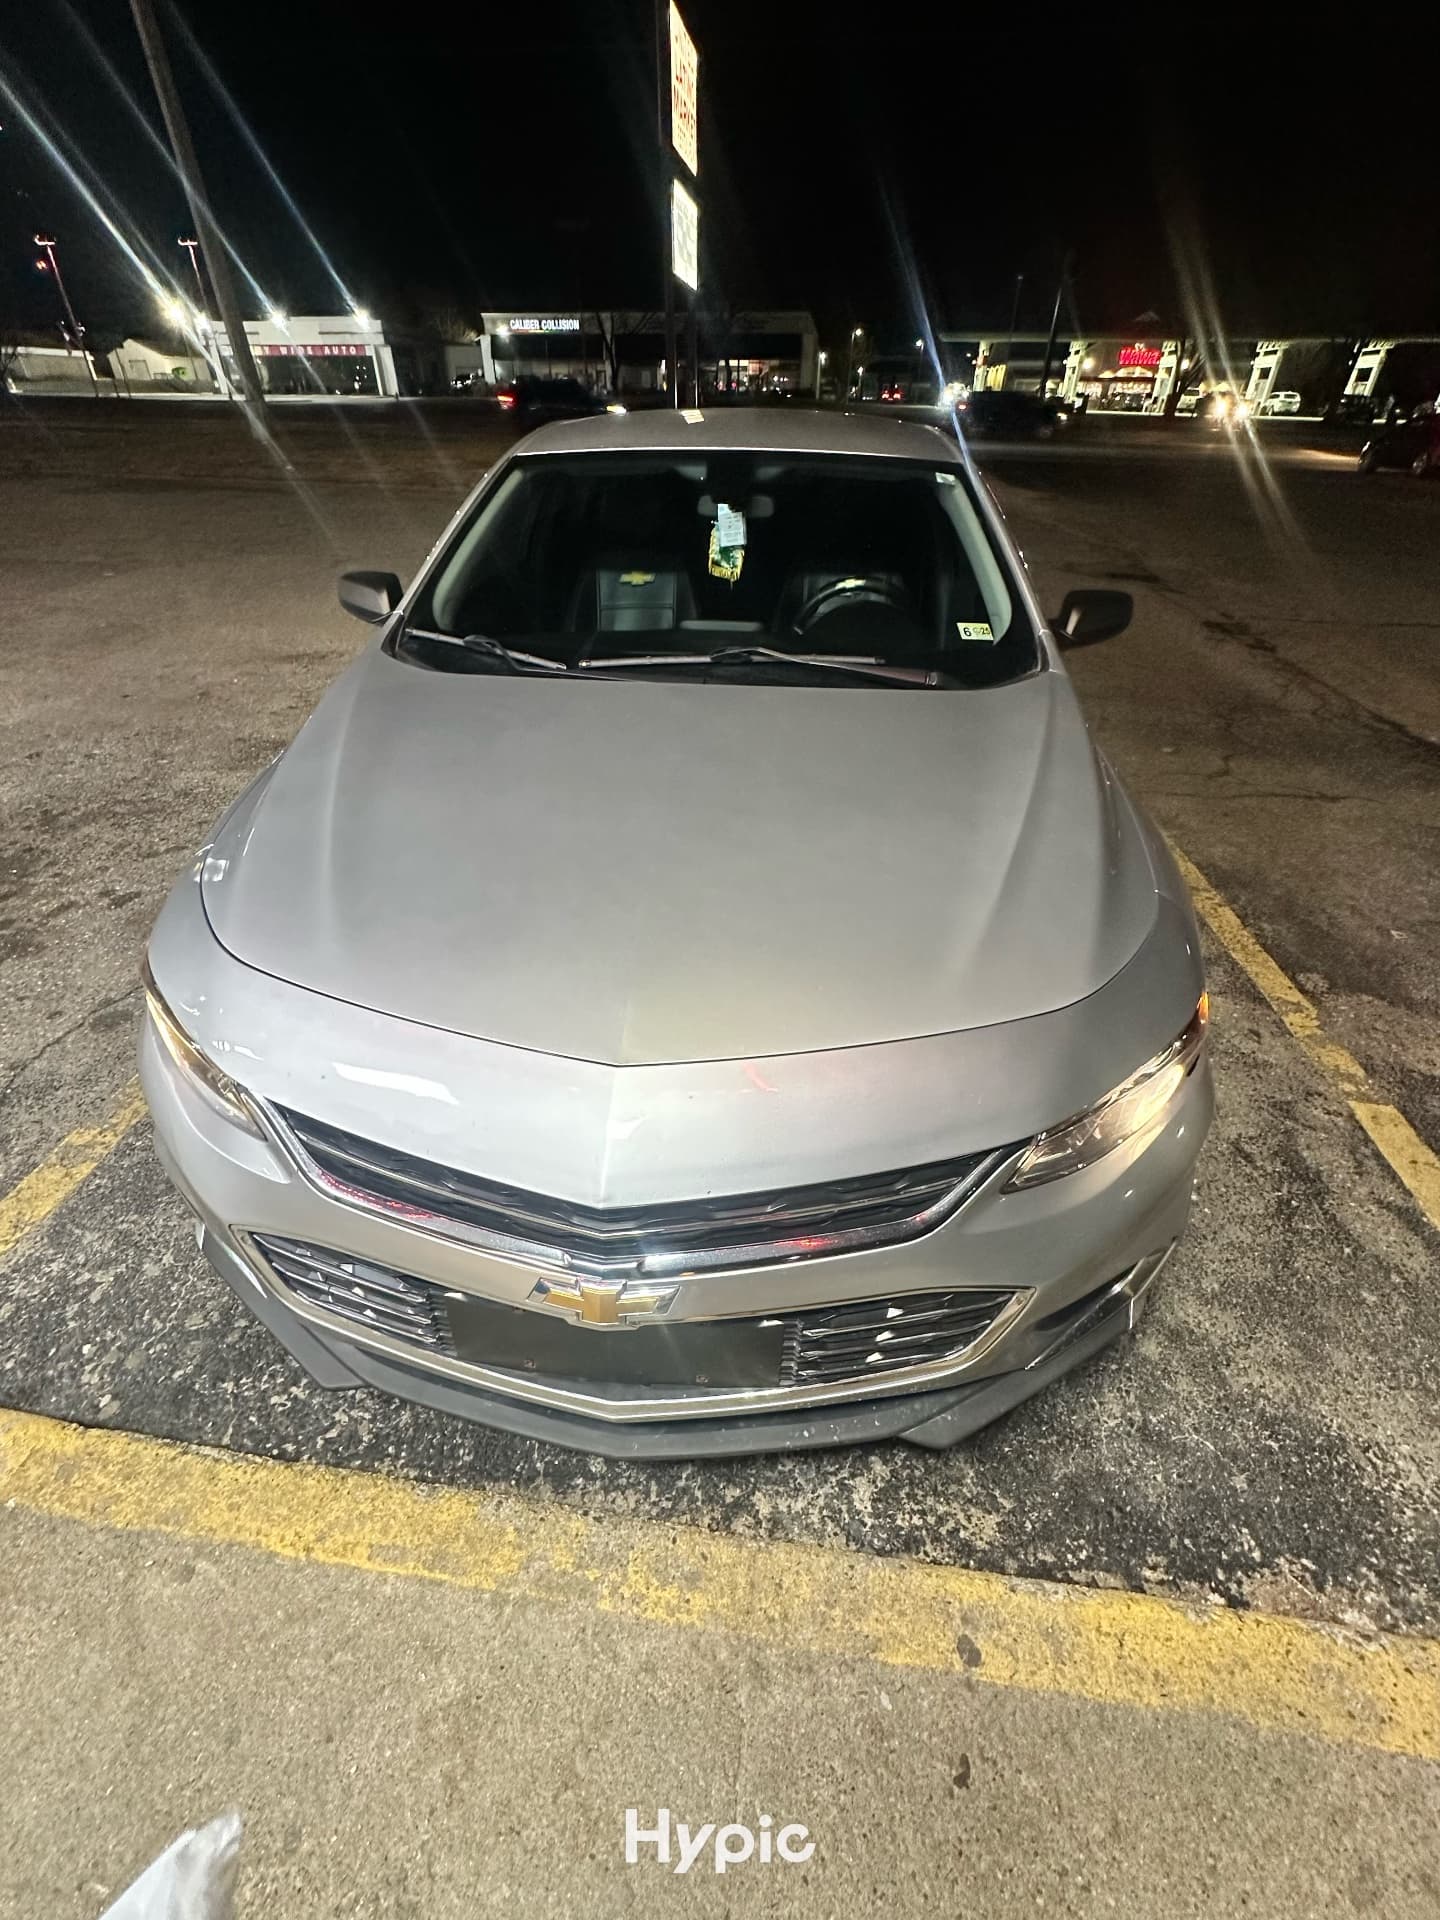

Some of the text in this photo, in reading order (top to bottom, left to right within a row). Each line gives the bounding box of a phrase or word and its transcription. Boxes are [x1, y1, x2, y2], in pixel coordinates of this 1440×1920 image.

[509, 319, 580, 330] CALIBER COLLISION
[324, 345, 357, 356] AUTO
[963, 627, 972, 637] 6
